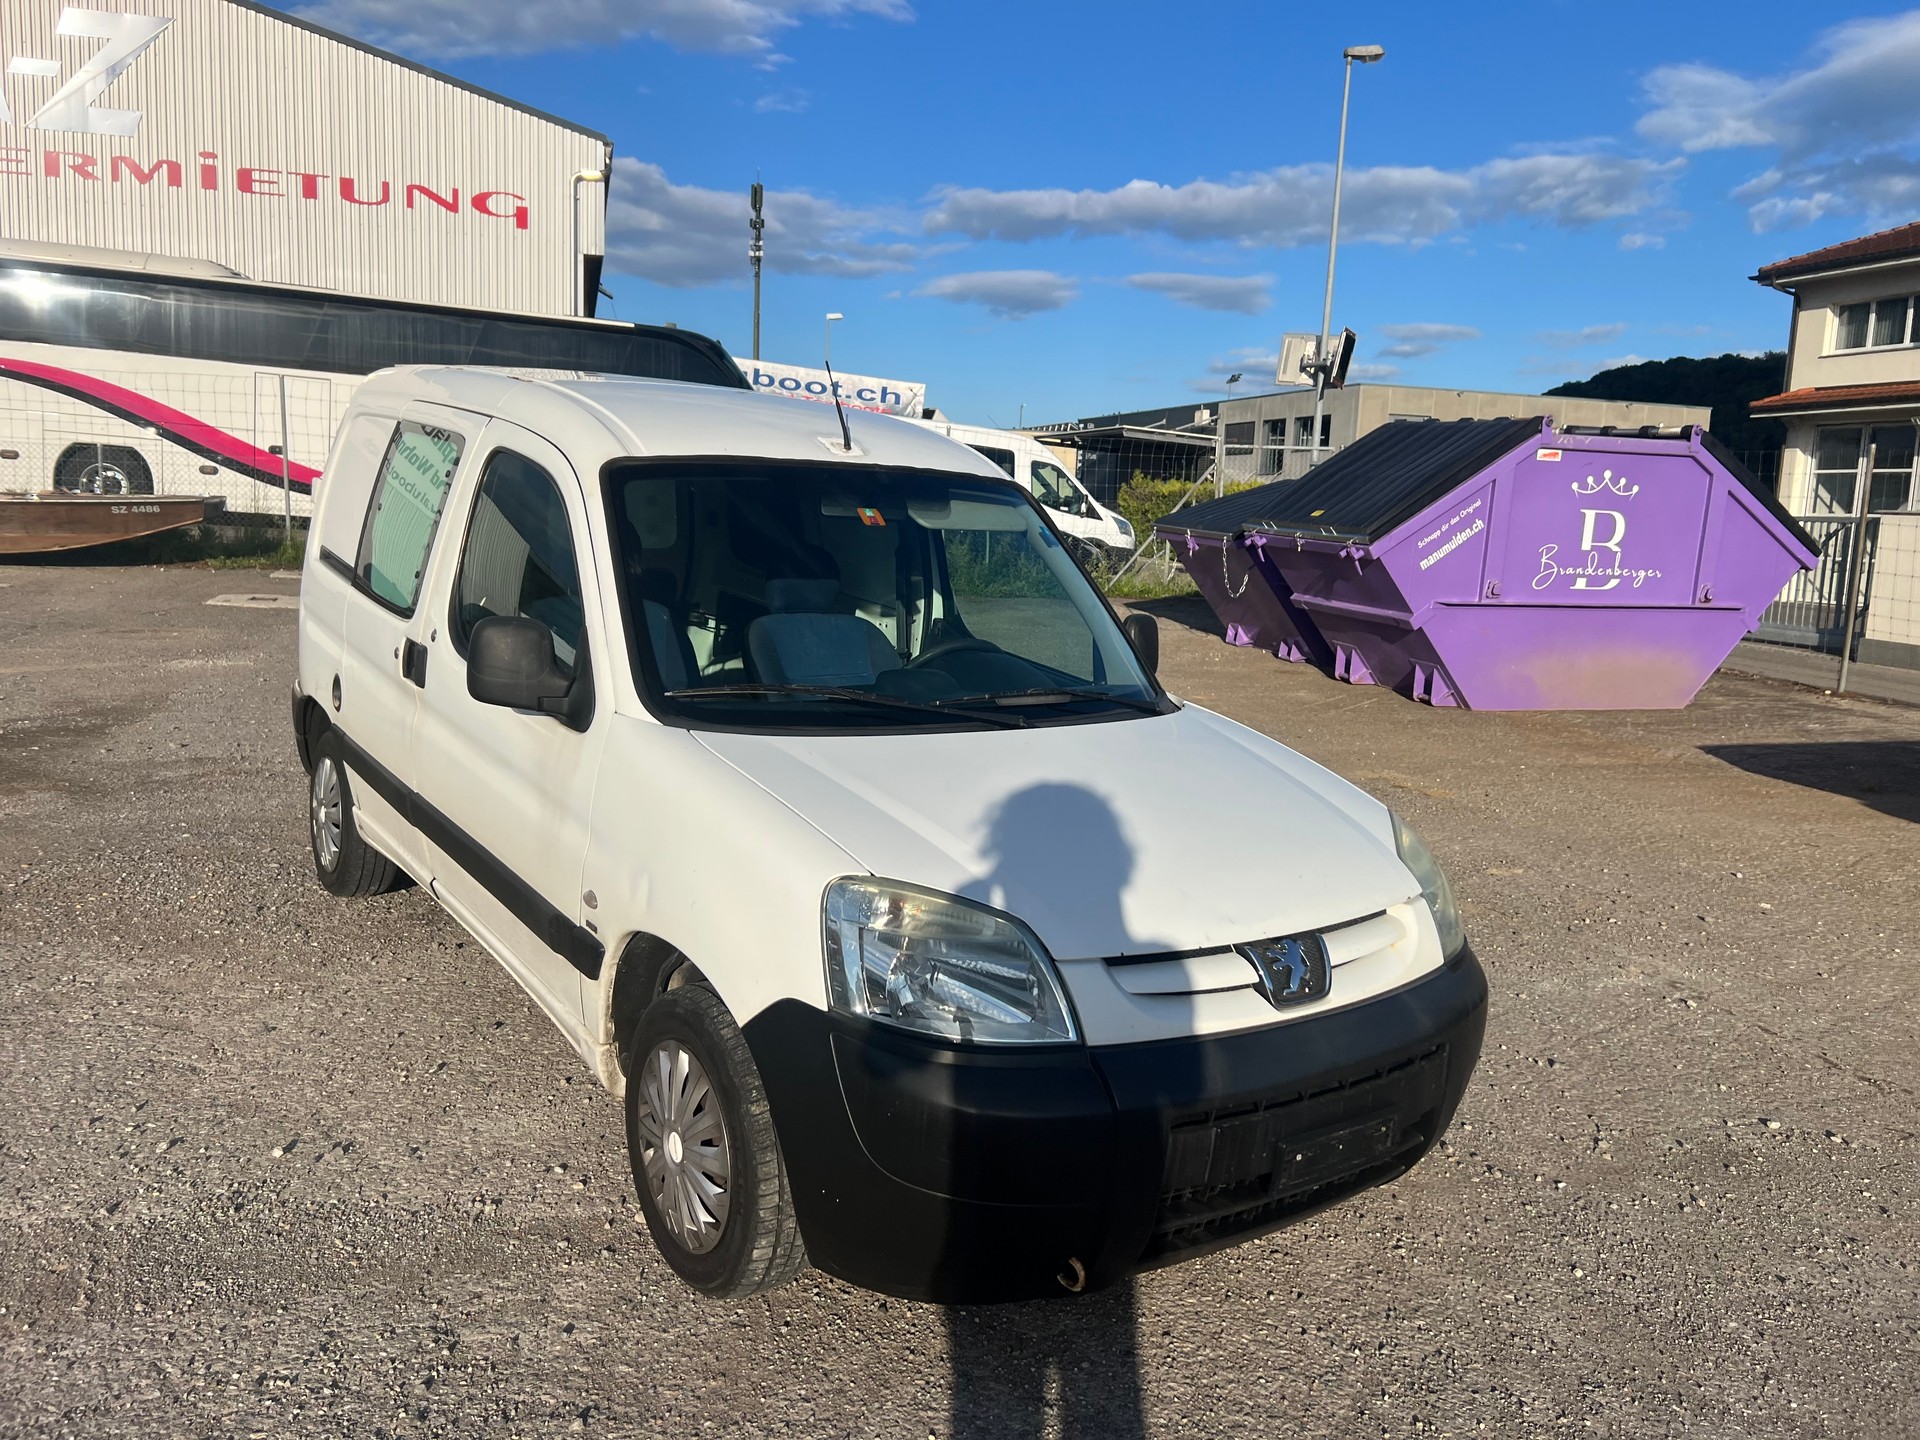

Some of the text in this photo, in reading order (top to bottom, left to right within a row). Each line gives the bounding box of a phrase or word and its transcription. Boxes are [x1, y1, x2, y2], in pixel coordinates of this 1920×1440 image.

[111, 504, 160, 514] SZ 4486
[1417, 498, 1482, 549] Schnapp dir das Original
[1419, 518, 1485, 571] manumulden.ch
[1532, 544, 1662, 590] Brandenberger
